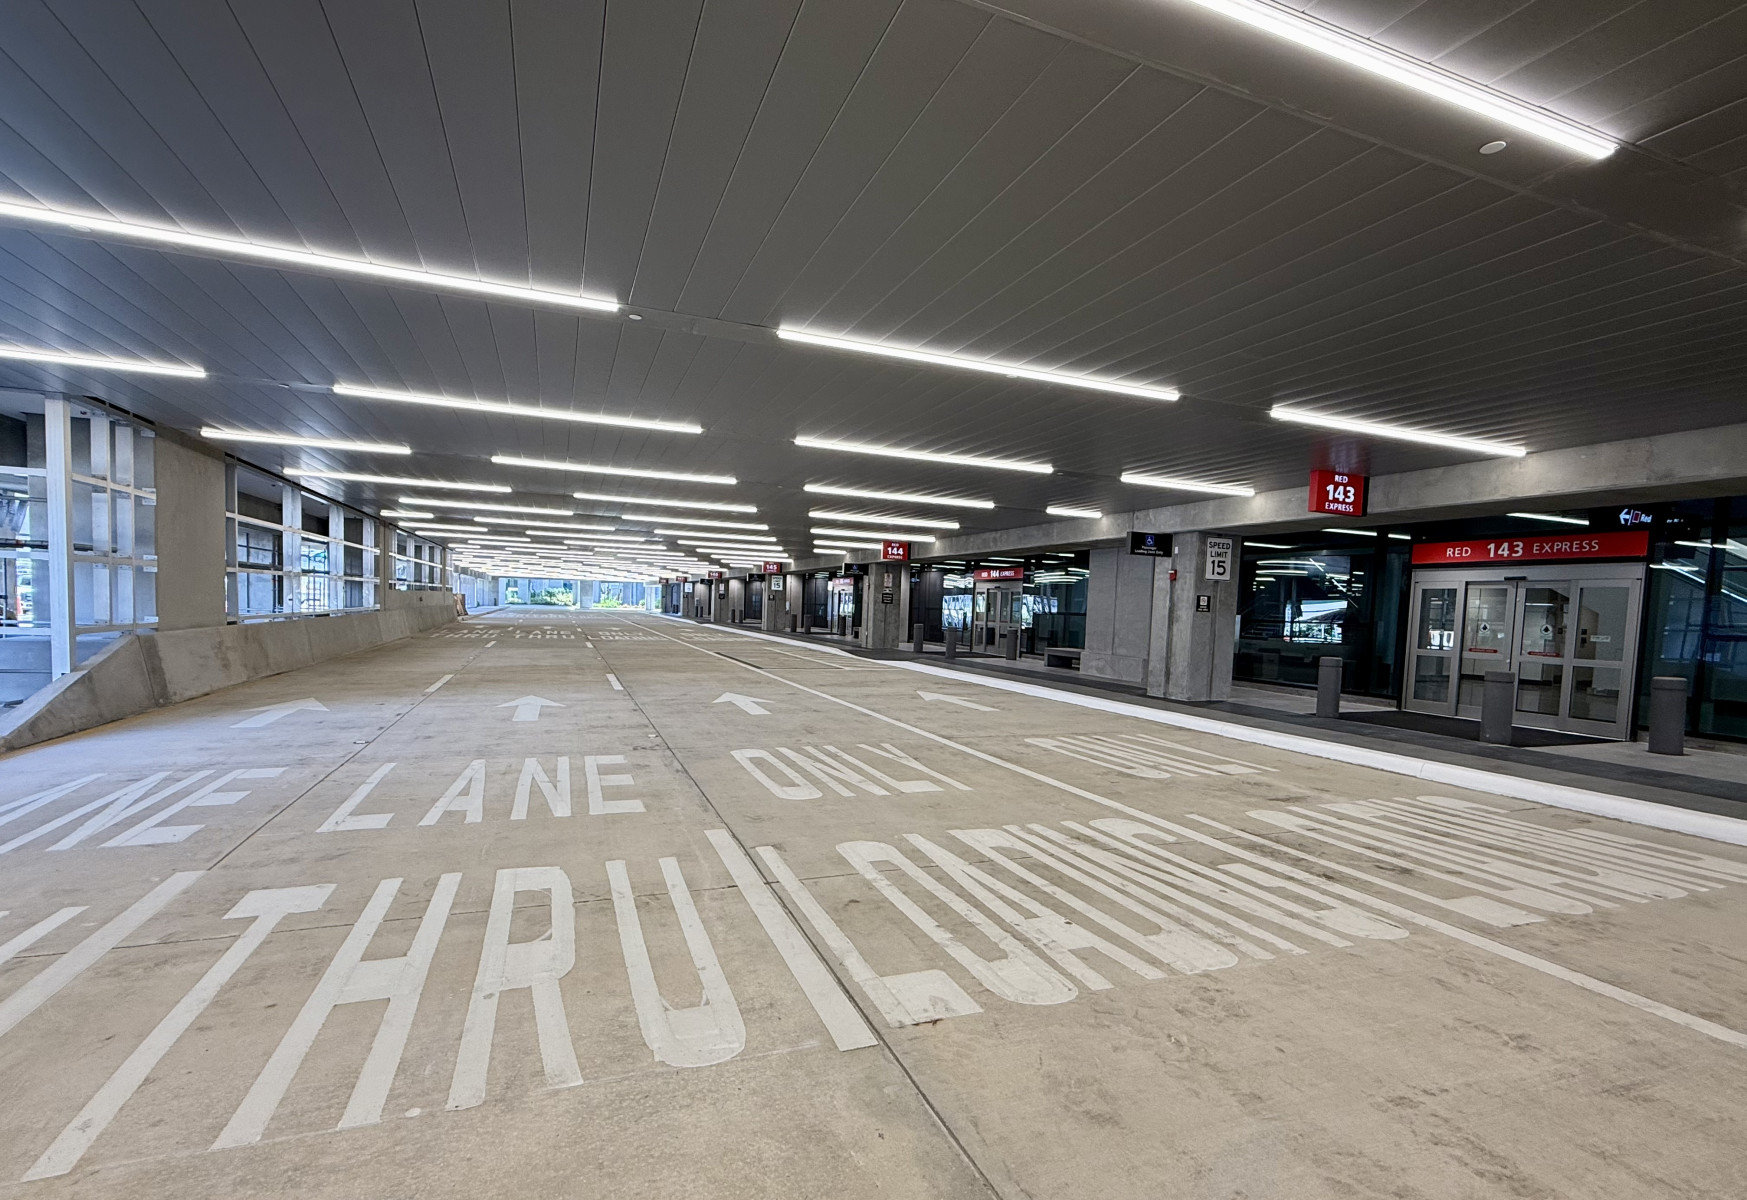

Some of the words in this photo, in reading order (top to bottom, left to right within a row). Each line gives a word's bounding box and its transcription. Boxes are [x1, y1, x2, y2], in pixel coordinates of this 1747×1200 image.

[1334, 474, 1348, 483] RED
[1326, 484, 1355, 503] 143
[1325, 502, 1353, 512] EXPRESS
[887, 547, 904, 555] 144
[1208, 541, 1231, 550] SPEED
[1446, 547, 1472, 557] RED
[1487, 541, 1524, 558] 143
[1533, 540, 1599, 554] EXPRESS
[1211, 560, 1226, 575] 15
[730, 743, 973, 800] ONLY
[316, 755, 646, 833] LANE
[755, 818, 1410, 1027] LOADING
[21, 856, 746, 1182] THRU
